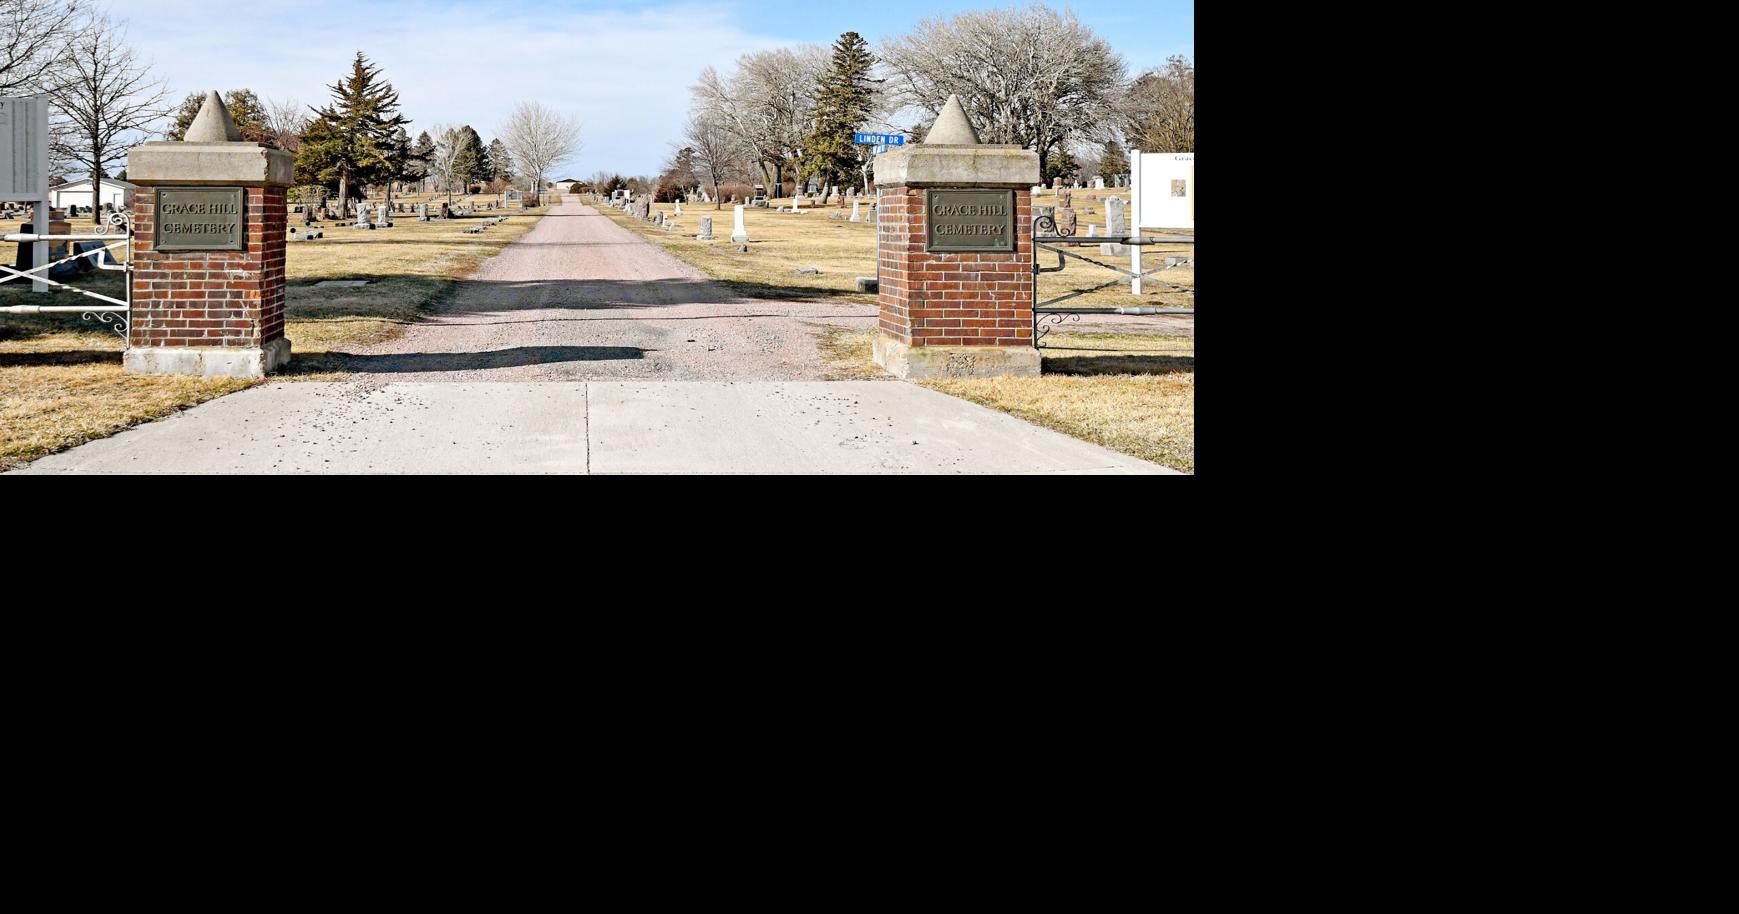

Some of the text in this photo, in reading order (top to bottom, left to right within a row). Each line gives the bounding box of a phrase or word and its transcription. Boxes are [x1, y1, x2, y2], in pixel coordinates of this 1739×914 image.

[859, 135, 899, 144] LINDEN DR
[162, 203, 238, 215] GRACE HILL
[933, 205, 1007, 216] GRACE HILL
[164, 223, 236, 234] CEMETERY
[935, 224, 1006, 235] CEMETERY
